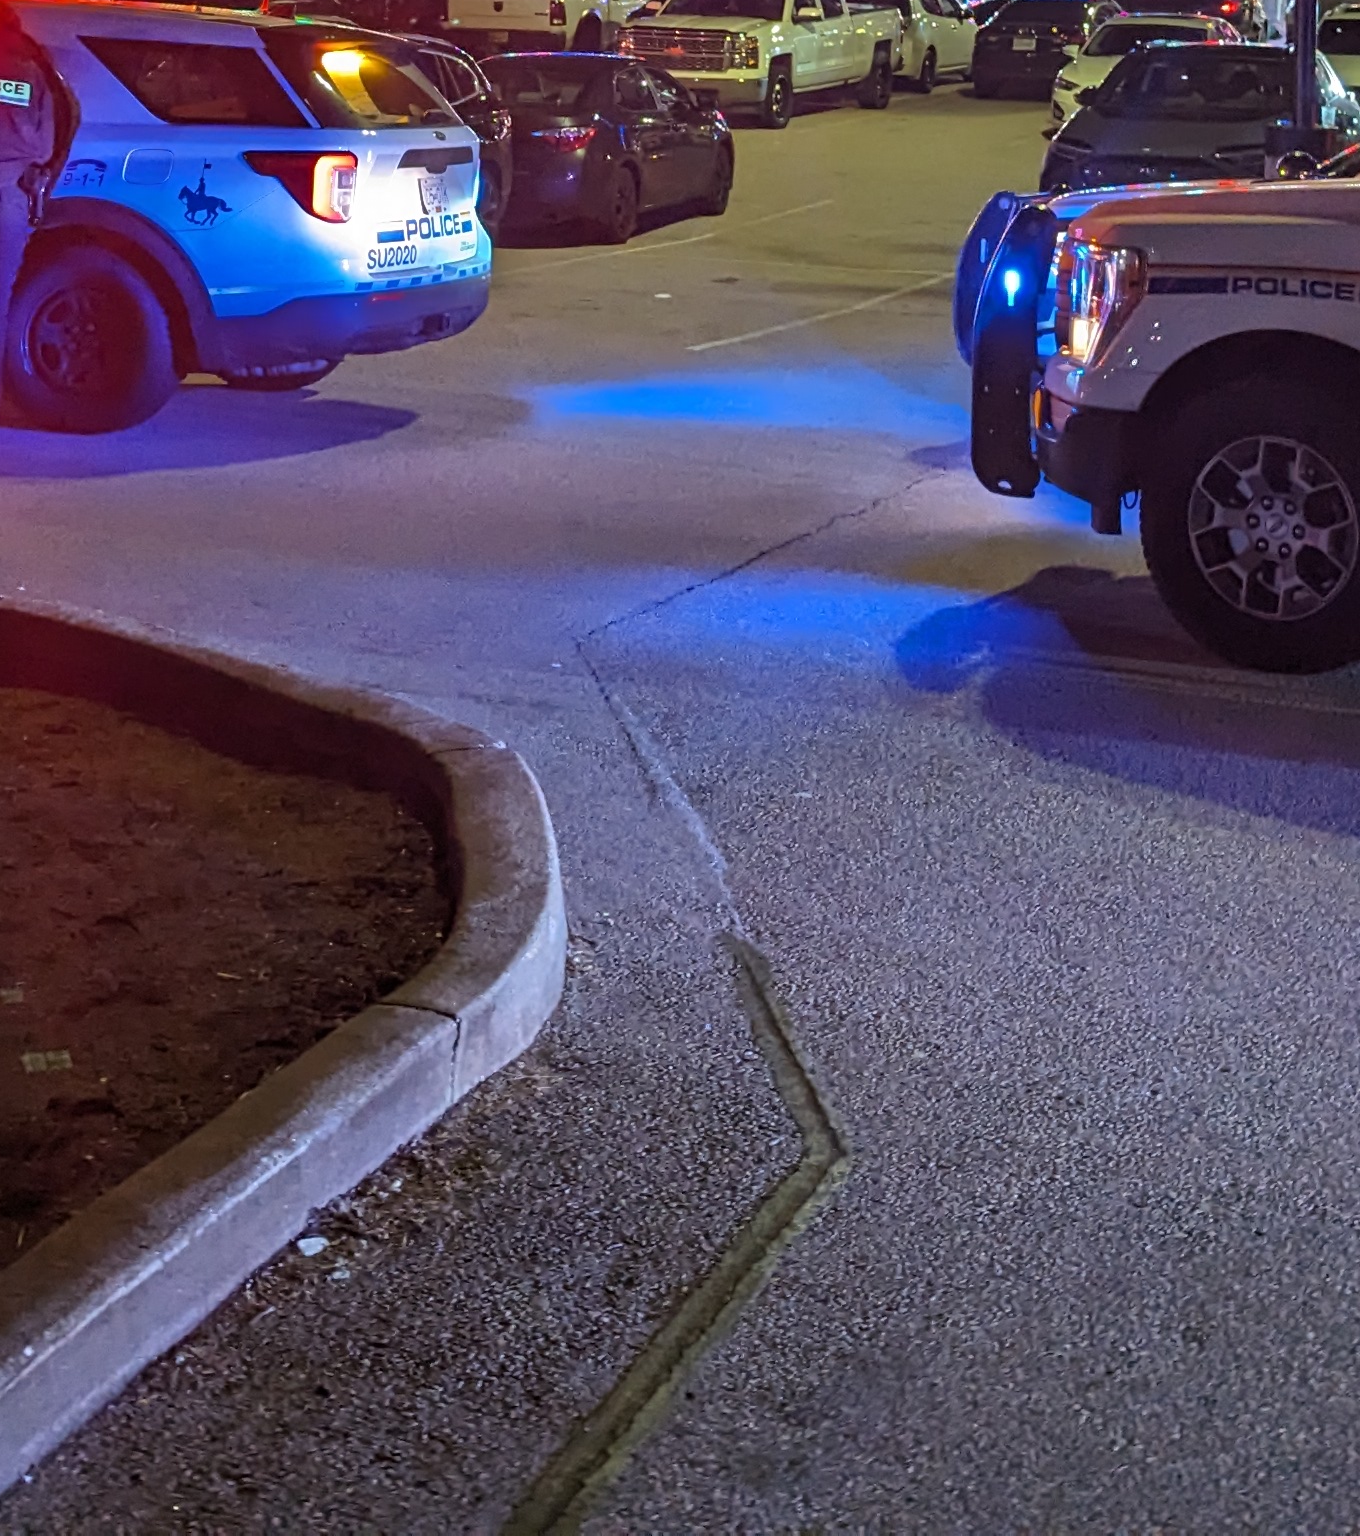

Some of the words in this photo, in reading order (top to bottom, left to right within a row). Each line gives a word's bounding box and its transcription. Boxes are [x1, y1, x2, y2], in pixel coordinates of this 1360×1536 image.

[63, 172, 105, 188] 9-1-1
[405, 213, 461, 241] POLICE
[367, 244, 418, 270] SU2020
[1231, 276, 1356, 302] POLICE
